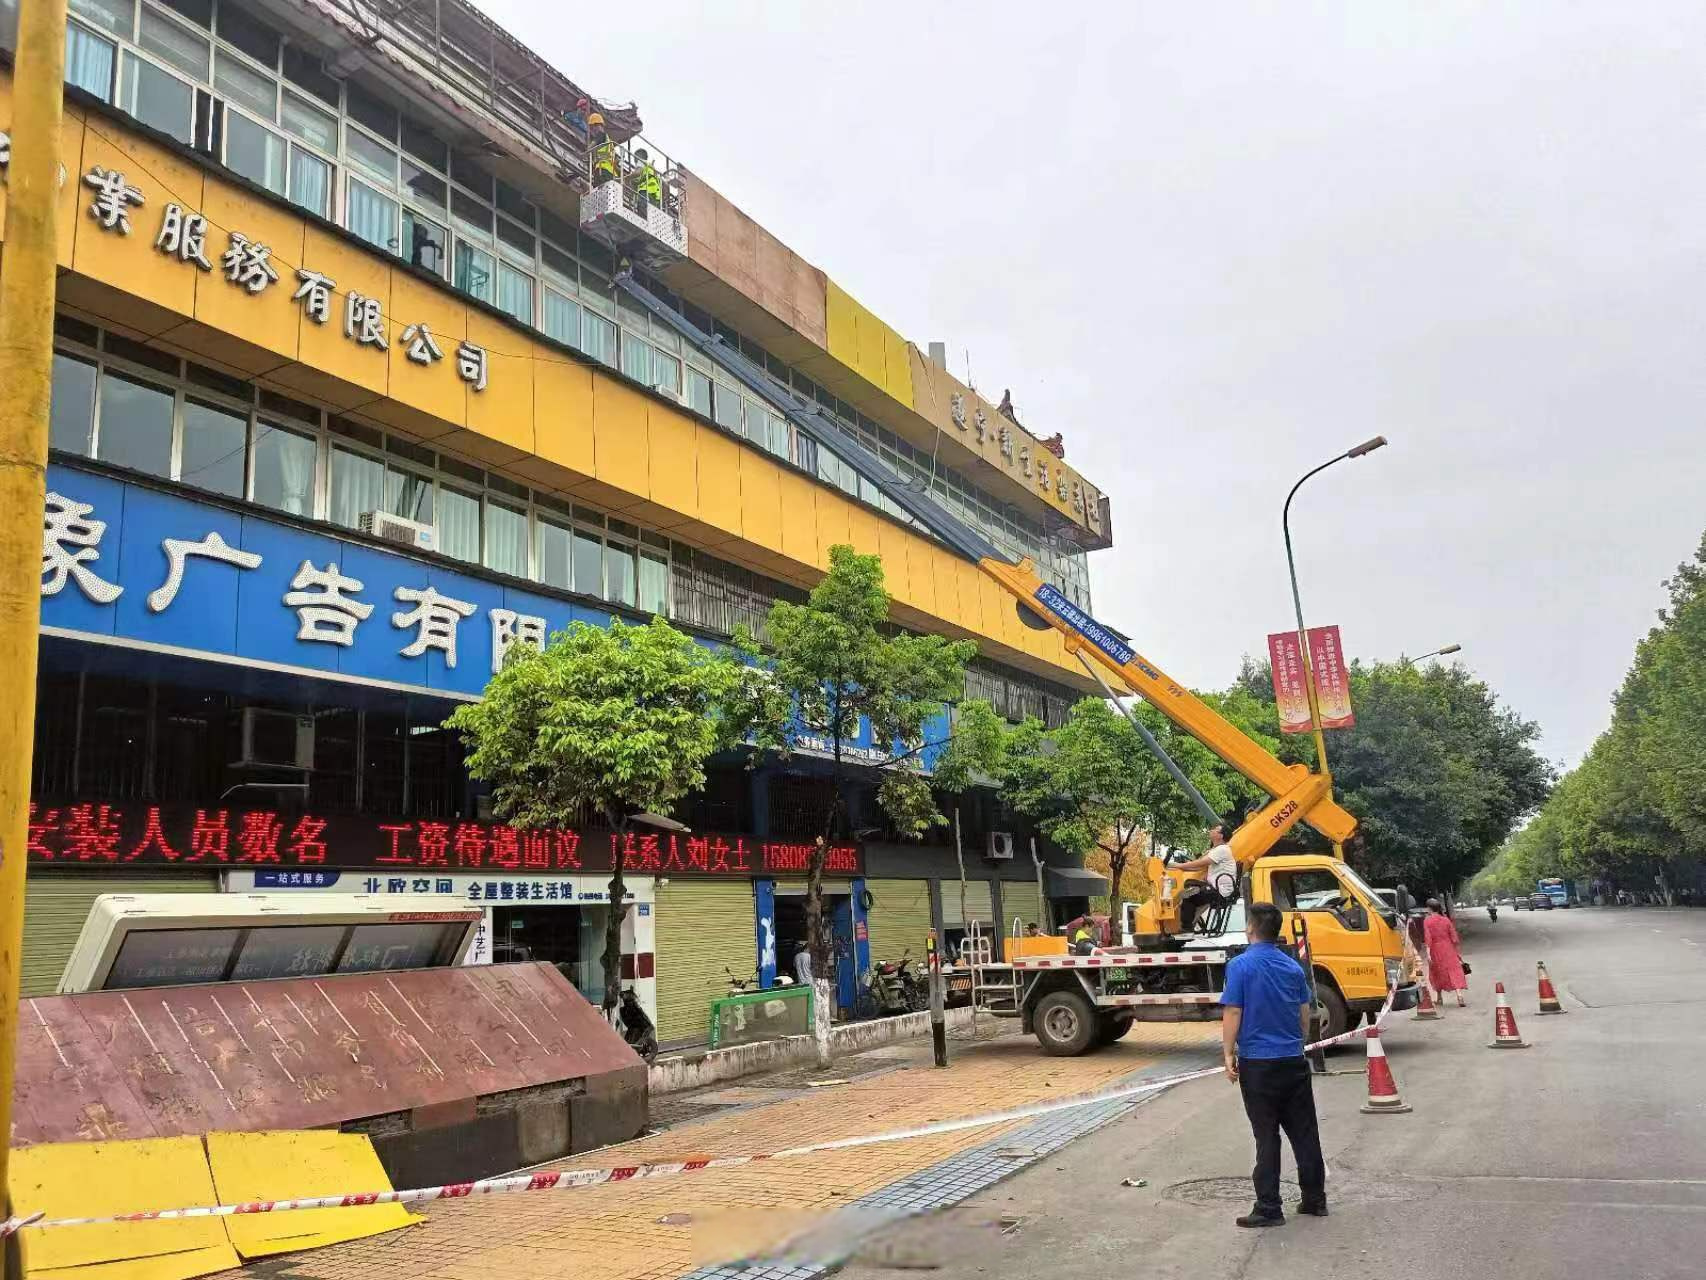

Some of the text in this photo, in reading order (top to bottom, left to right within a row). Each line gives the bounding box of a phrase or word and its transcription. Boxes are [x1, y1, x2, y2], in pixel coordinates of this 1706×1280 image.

[57, 160, 489, 392] 業服務有限公司
[1270, 800, 1298, 828] GKS28
[376, 820, 582, 869] 工资待遇面议
[610, 832, 752, 871] 联系人刘女士
[265, 872, 325, 884] 一站式服务
[467, 881, 573, 901] 全屋整装生活馆
